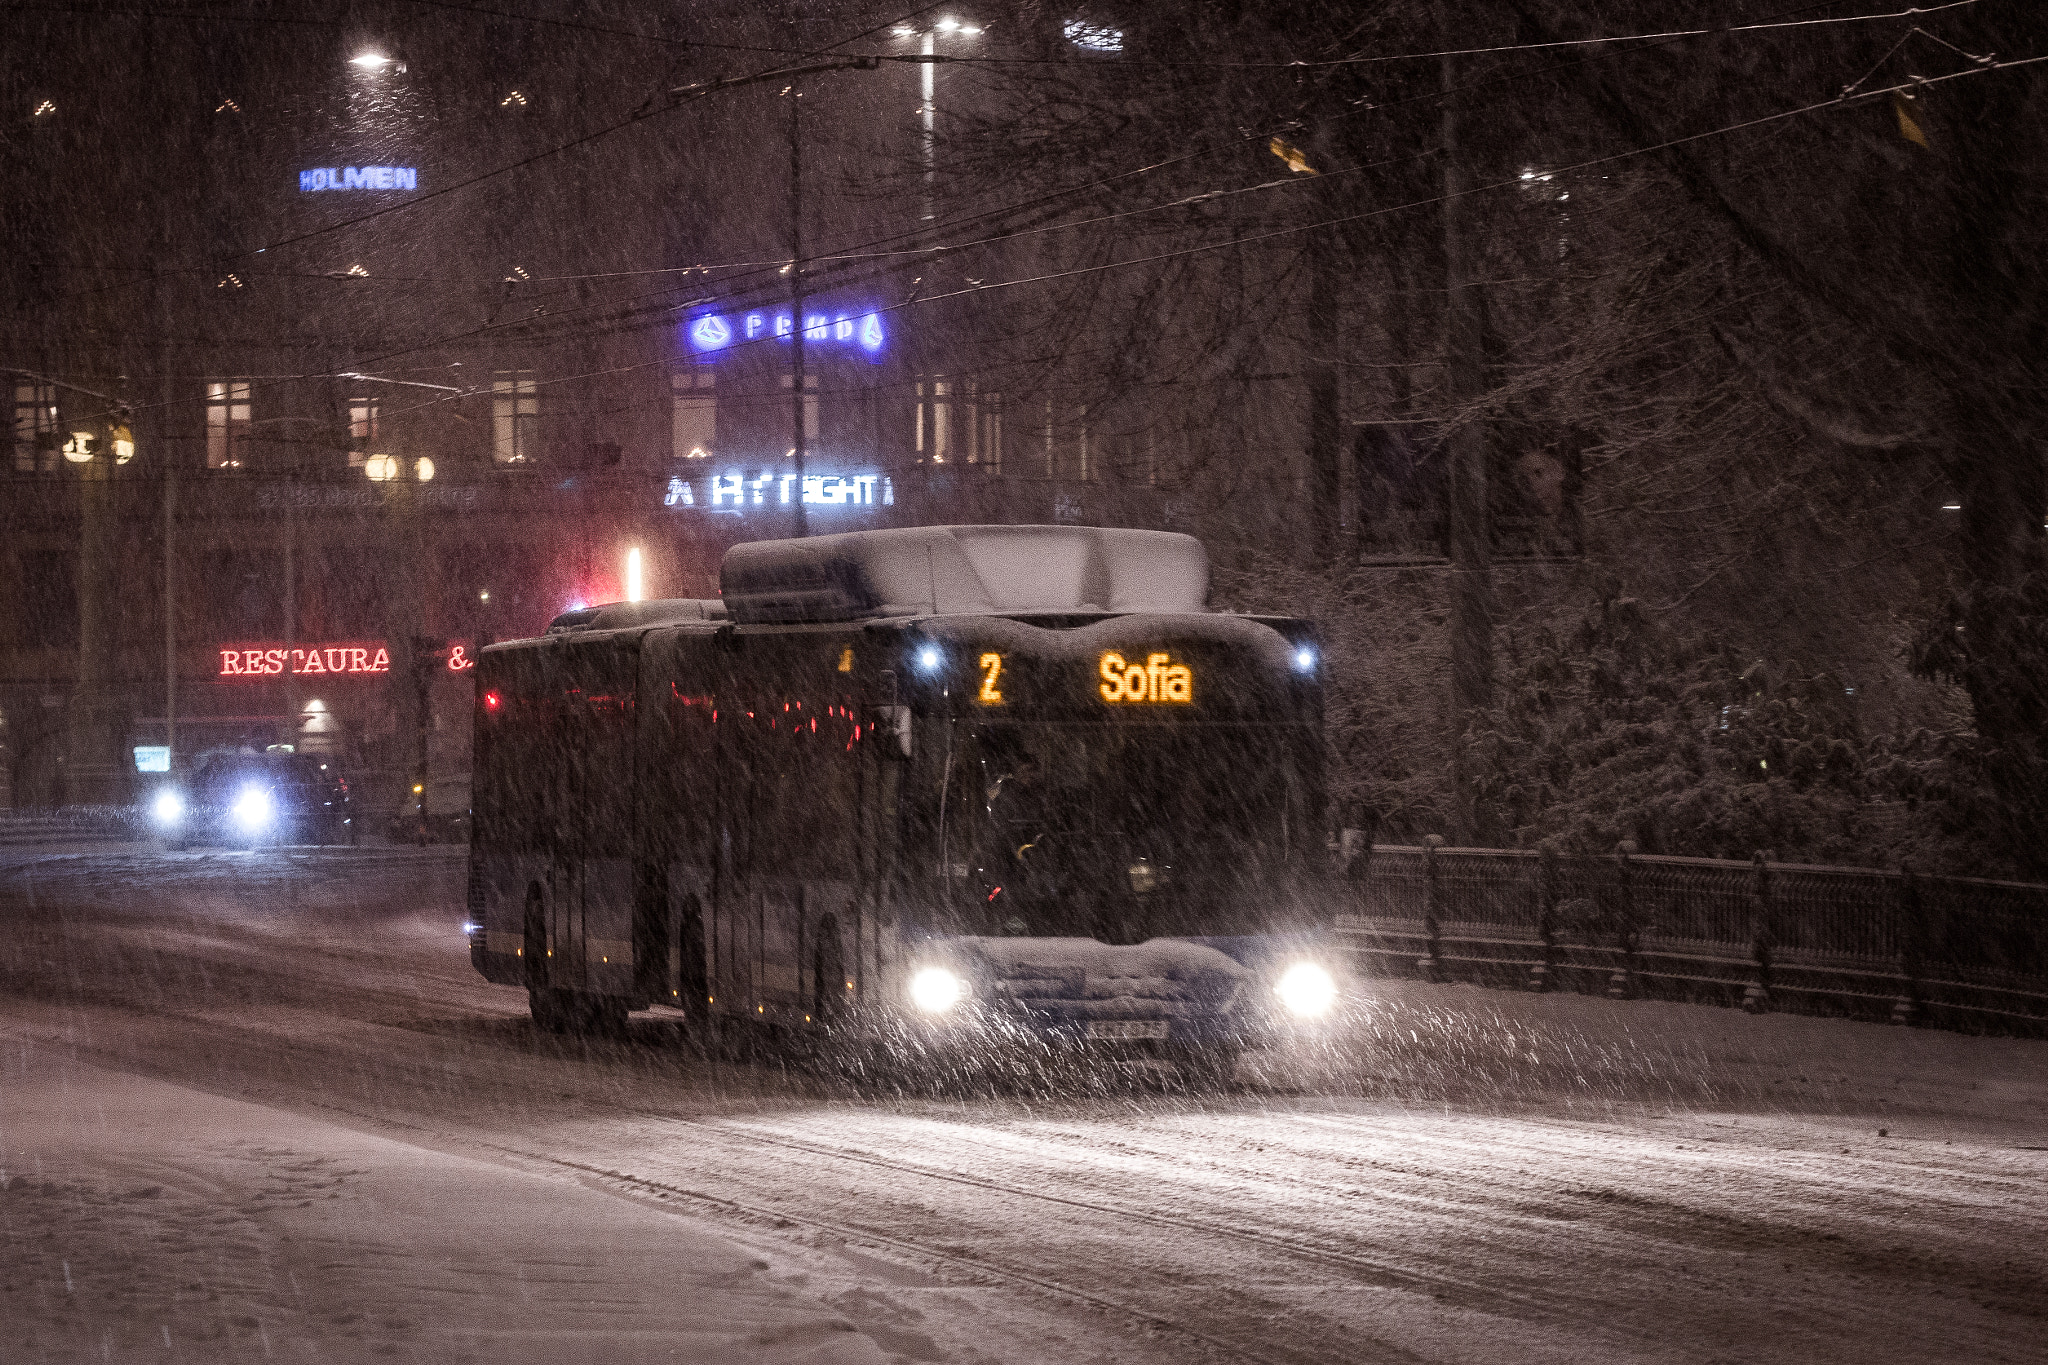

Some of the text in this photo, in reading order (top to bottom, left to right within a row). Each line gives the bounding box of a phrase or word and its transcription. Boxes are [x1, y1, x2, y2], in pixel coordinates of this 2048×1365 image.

[299, 166, 417, 191] HOLMEN
[219, 648, 389, 675] RESTAURA
[979, 651, 1192, 702] 2 Sofia
